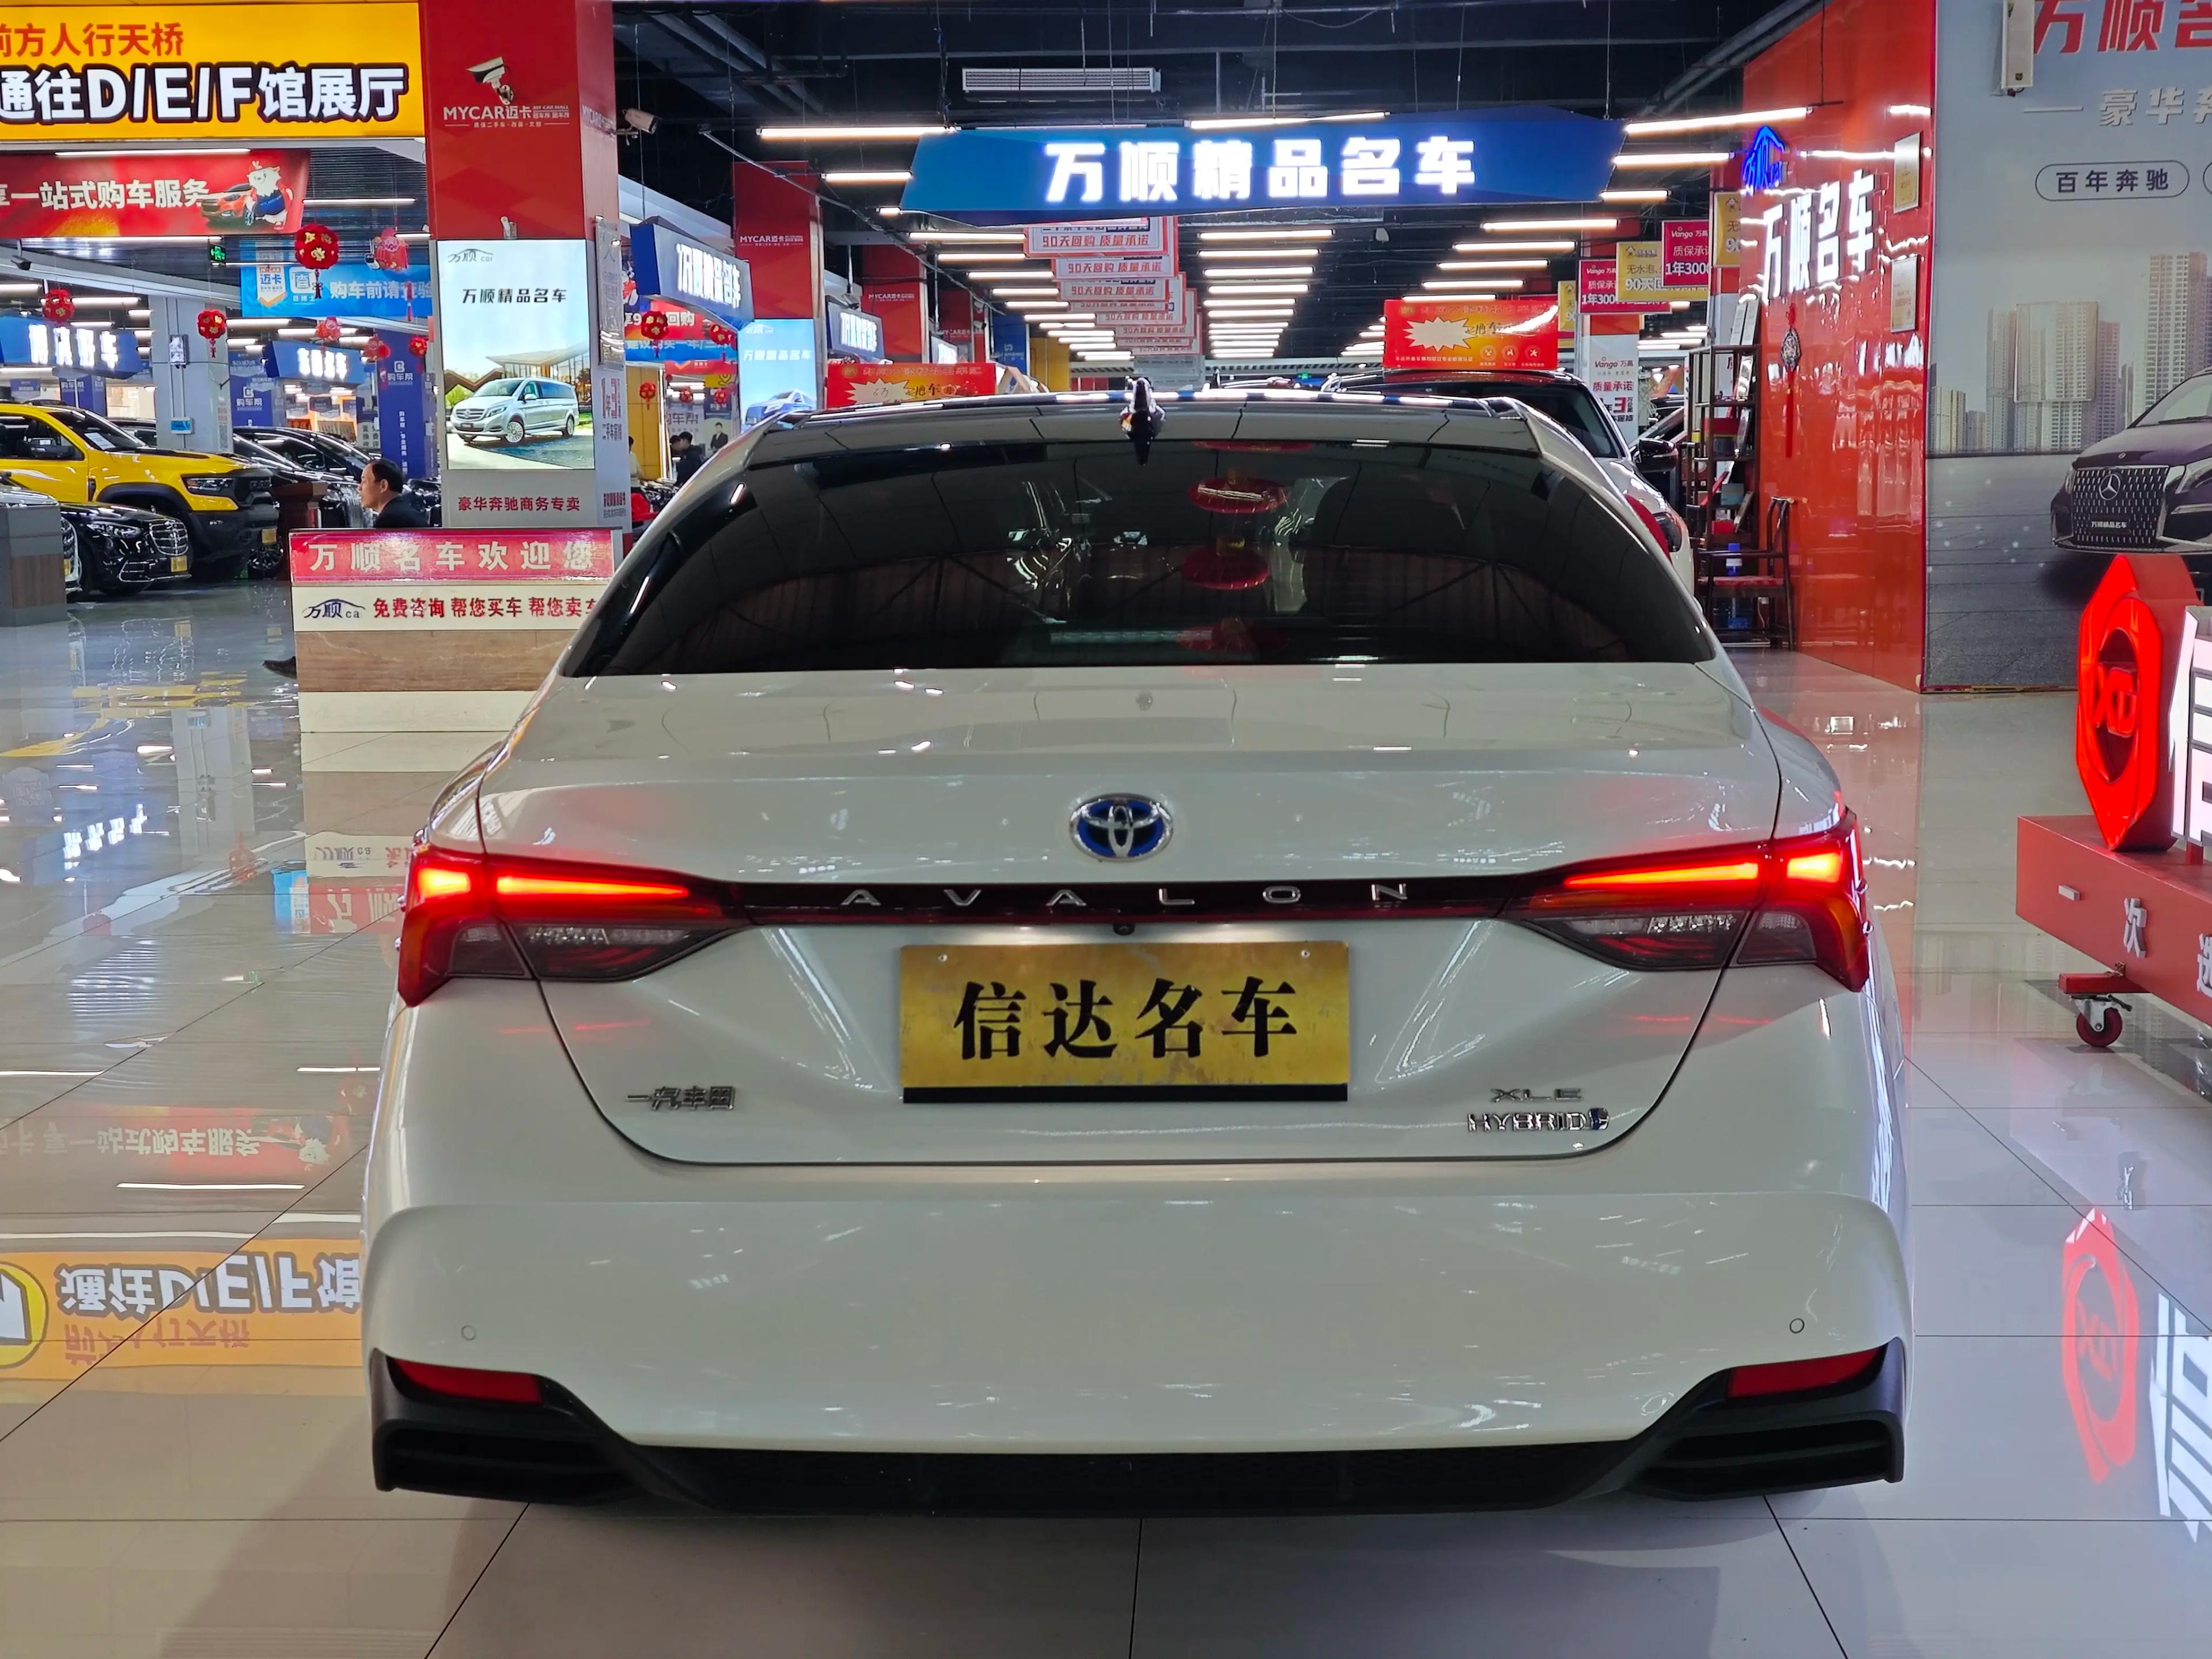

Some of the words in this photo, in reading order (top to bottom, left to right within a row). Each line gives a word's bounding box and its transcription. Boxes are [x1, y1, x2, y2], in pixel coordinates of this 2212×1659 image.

[1045, 136, 1476, 202] 万顺精品名车
[2056, 169, 2169, 193] 百年奔驰
[1100, 234, 1149, 246] 质量承诺
[1763, 169, 1875, 305] 万顺名车
[260, 274, 281, 285] 迈卡
[1588, 280, 1616, 290] 质保承
[463, 289, 566, 304] 万顺精品名车
[1593, 381, 1633, 392] 质量承诺
[458, 497, 580, 511] 豪华奔驰商务专卖
[309, 540, 593, 571] 万顺名车欢迎您
[373, 597, 445, 618] 免费咨询
[451, 597, 522, 618] 帮您买车
[840, 883, 1407, 907] AVALON
[953, 977, 1296, 1060] 信达名车
[1490, 1088, 1582, 1103] XLE
[1468, 1112, 1586, 1131] HYBRID
